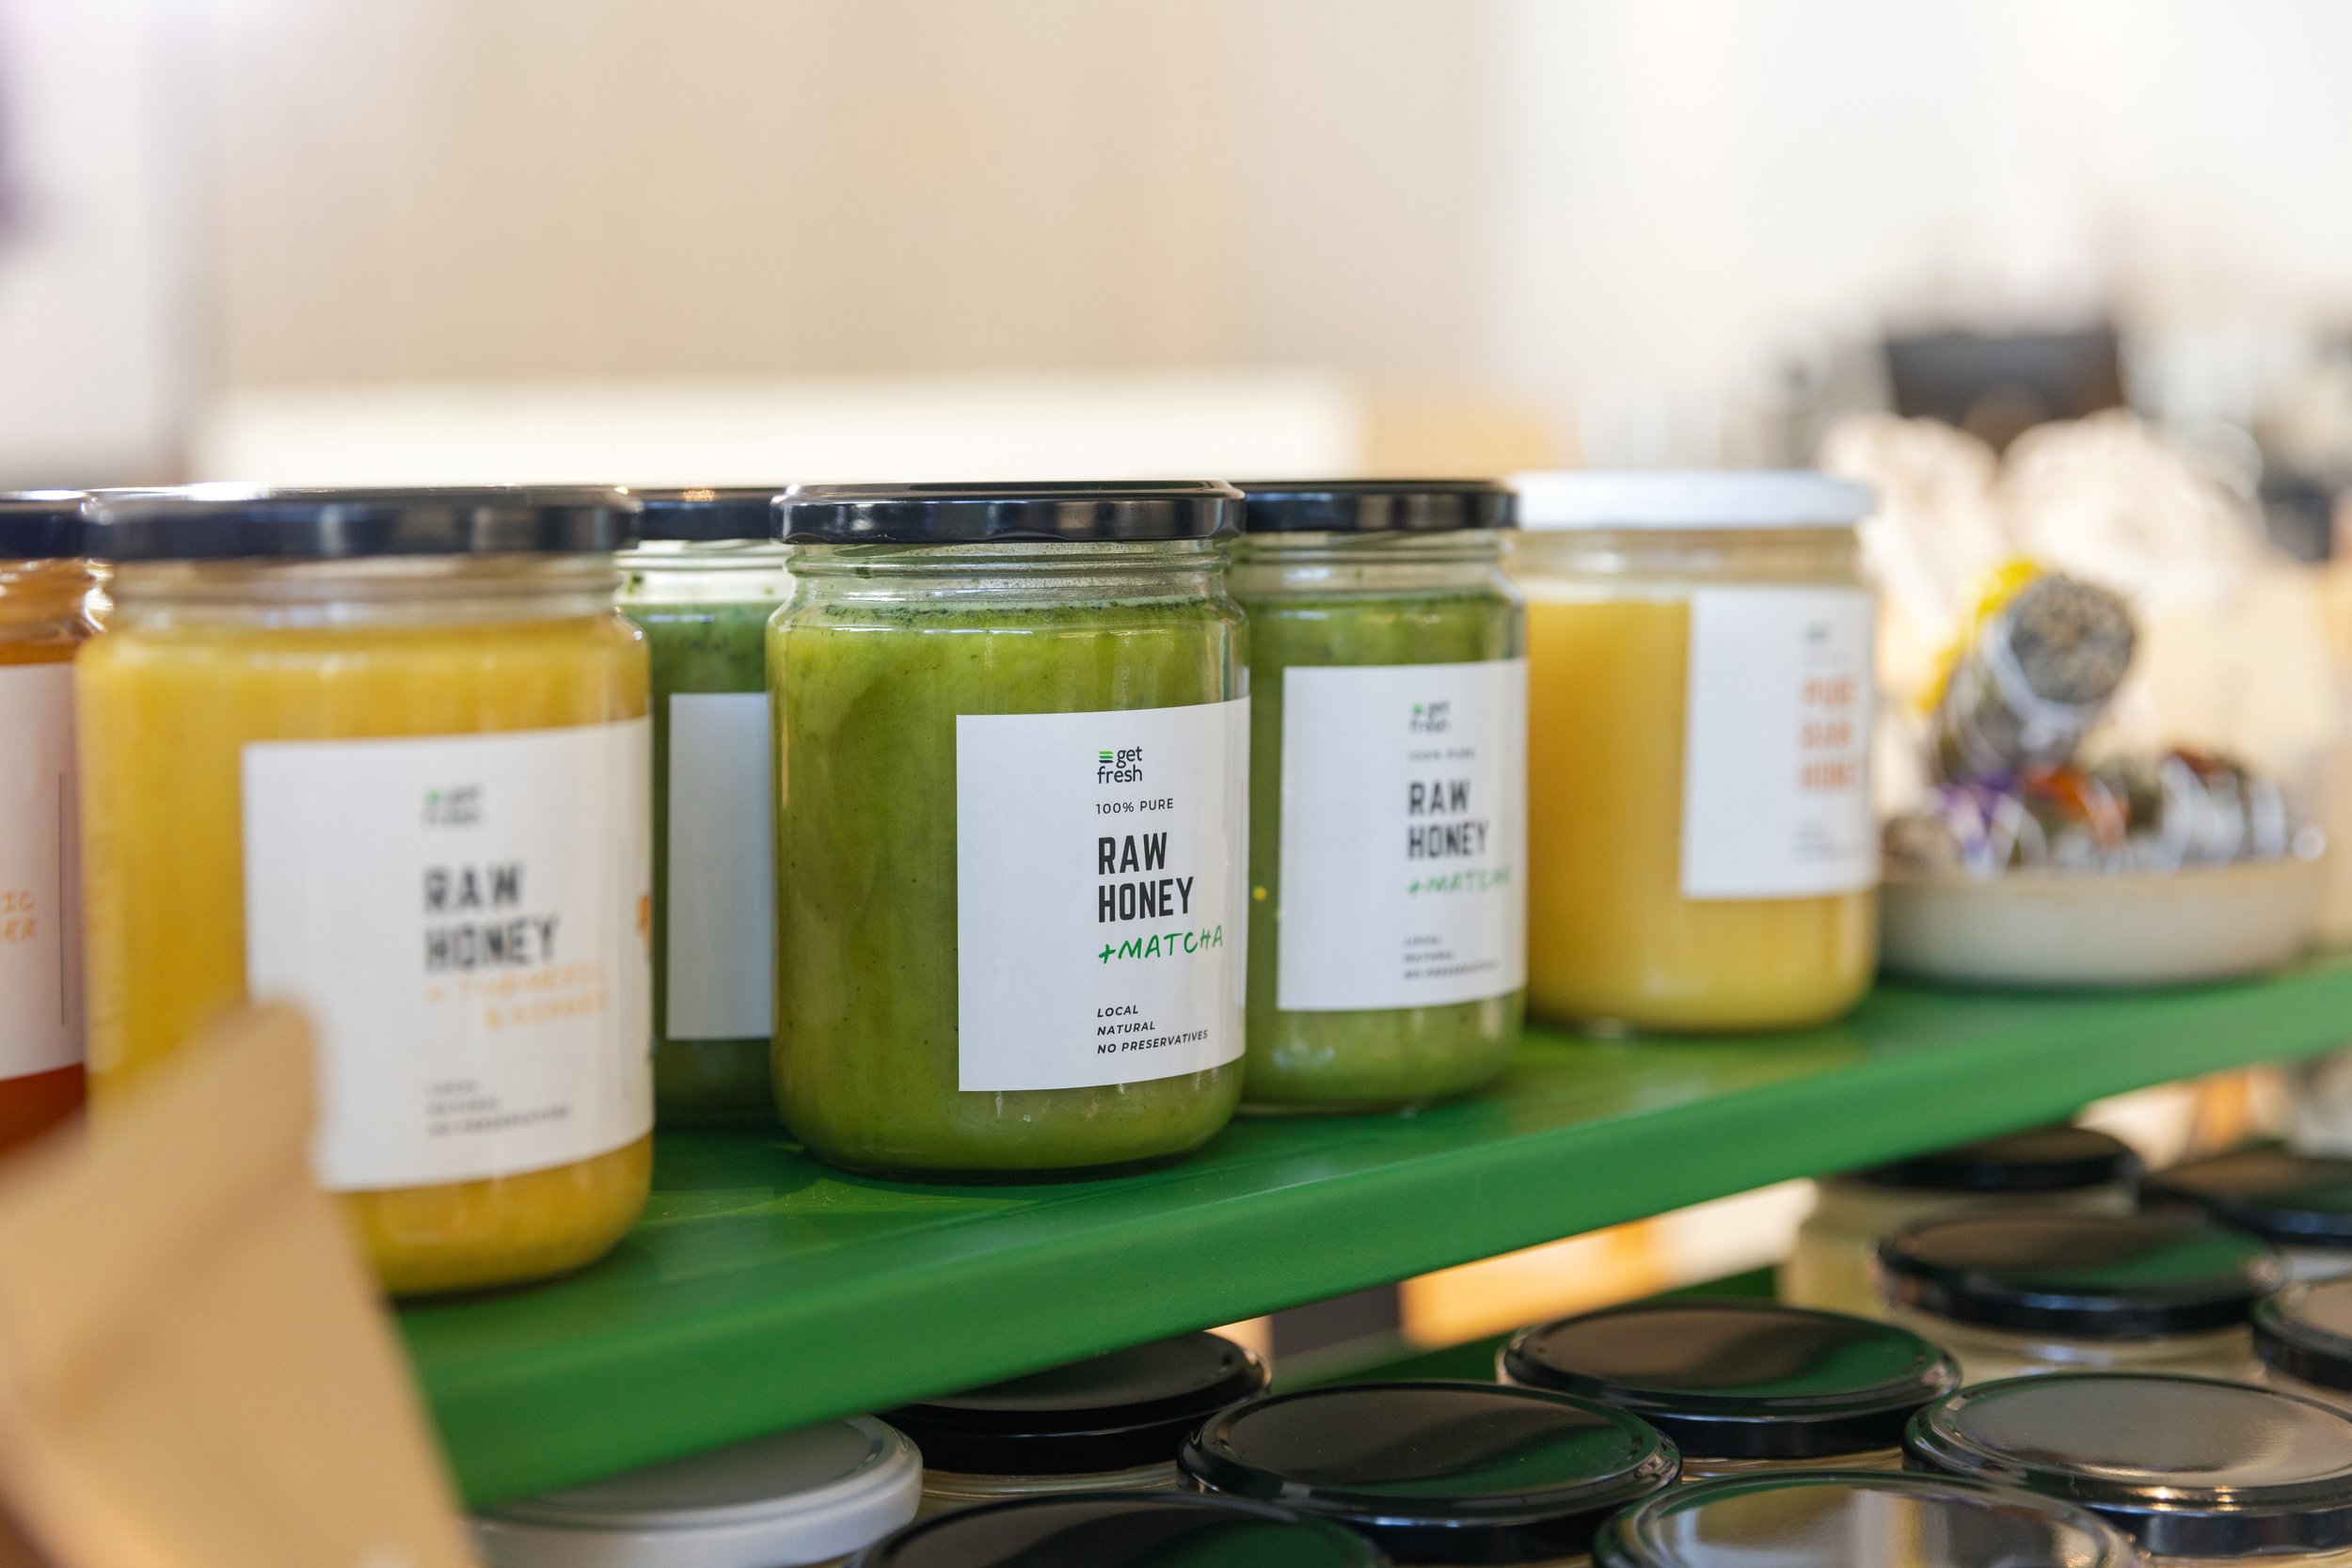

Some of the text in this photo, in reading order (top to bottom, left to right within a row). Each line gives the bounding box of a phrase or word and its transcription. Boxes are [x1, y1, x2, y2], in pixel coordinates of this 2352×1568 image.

[1097, 764, 1142, 784] fresh
[1116, 746, 1142, 768] get
[1096, 798, 1174, 815] 100% PURE
[1408, 779, 1470, 816] RAW
[1098, 832, 1168, 875] RAW
[1407, 820, 1489, 860] HONEY
[424, 860, 522, 909] RAW
[1098, 877, 1194, 923] HONEY
[424, 911, 559, 973] HONEY
[1098, 925, 1223, 964] +MATCHA
[1097, 1005, 1138, 1018] LOCAL
[1097, 1021, 1155, 1036] NATURAL
[1097, 1029, 1208, 1054] NO PRESERVATIVES
